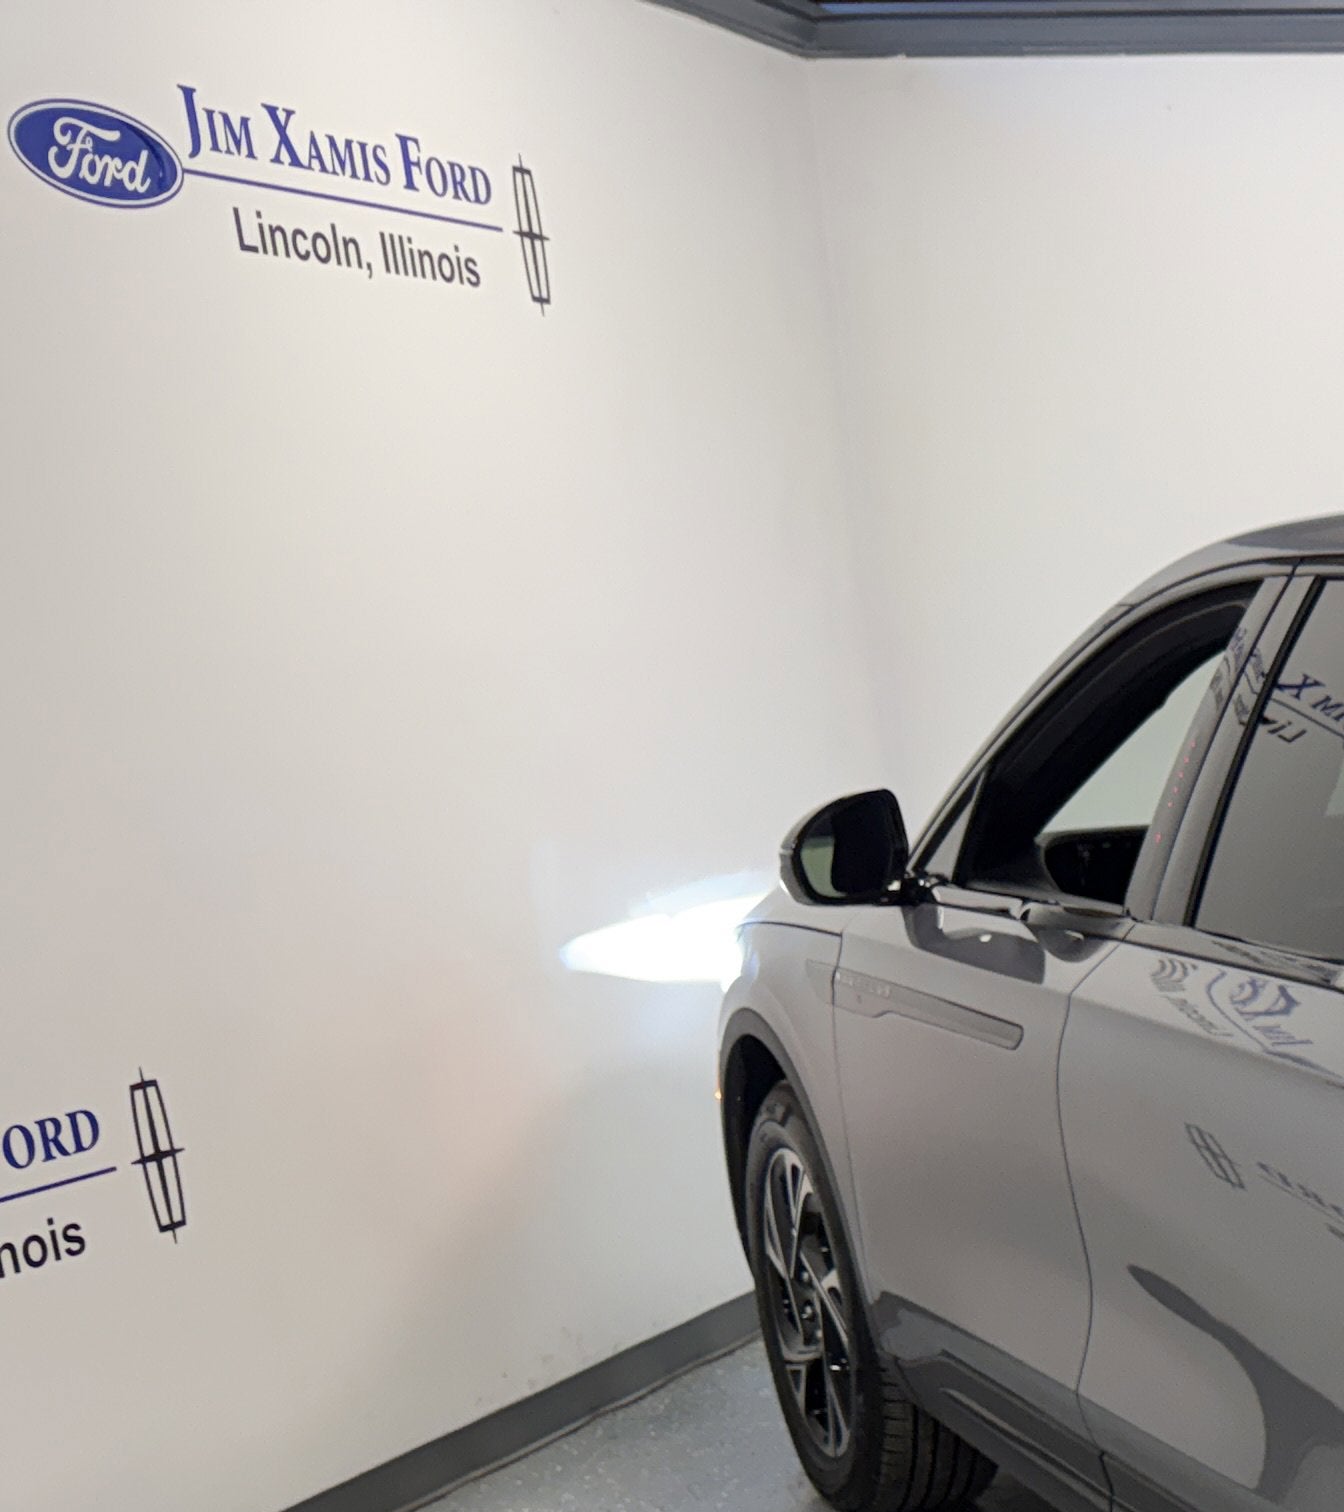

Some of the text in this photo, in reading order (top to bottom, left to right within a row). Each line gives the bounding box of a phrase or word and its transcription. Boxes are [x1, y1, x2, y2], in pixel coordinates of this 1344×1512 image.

[48, 116, 151, 194] Ford
[176, 84, 492, 205] JIM XAMIS FORD
[233, 207, 481, 288] Lincoln, Illinois
[1, 1109, 99, 1169] ORD
[0, 1217, 86, 1279] nois
